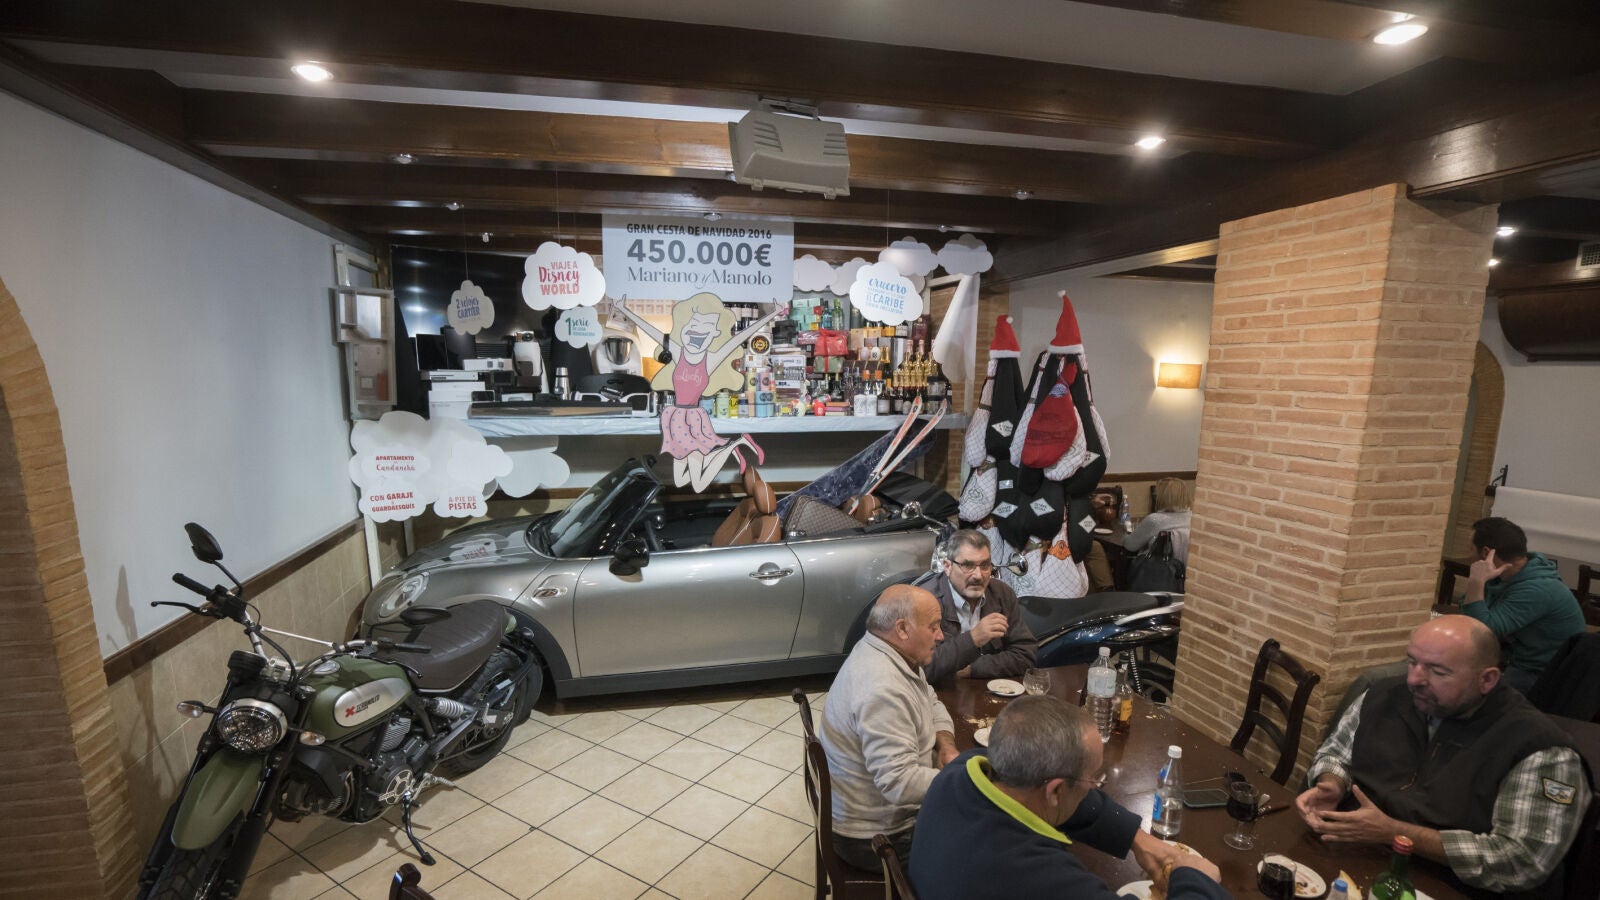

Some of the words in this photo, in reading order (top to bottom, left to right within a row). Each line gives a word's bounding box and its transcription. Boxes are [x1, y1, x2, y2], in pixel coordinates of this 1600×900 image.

[626, 223, 654, 234] GRAN
[656, 224, 686, 235] CESTA
[687, 226, 700, 235] DE
[702, 226, 746, 238] NAVIDAD
[748, 229, 772, 239] 2016
[627, 239, 772, 267] 450.000€
[550, 261, 571, 270] VIAJE
[572, 261, 578, 269] A
[538, 266, 580, 283] Disney
[628, 266, 698, 283] Mariano
[712, 269, 772, 286] Manolo
[540, 283, 580, 295] WORLD
[873, 293, 904, 309] CARIBE
[565, 317, 572, 336] 1
[386, 492, 414, 501] GARAJE
[448, 502, 477, 511] PISTAS
